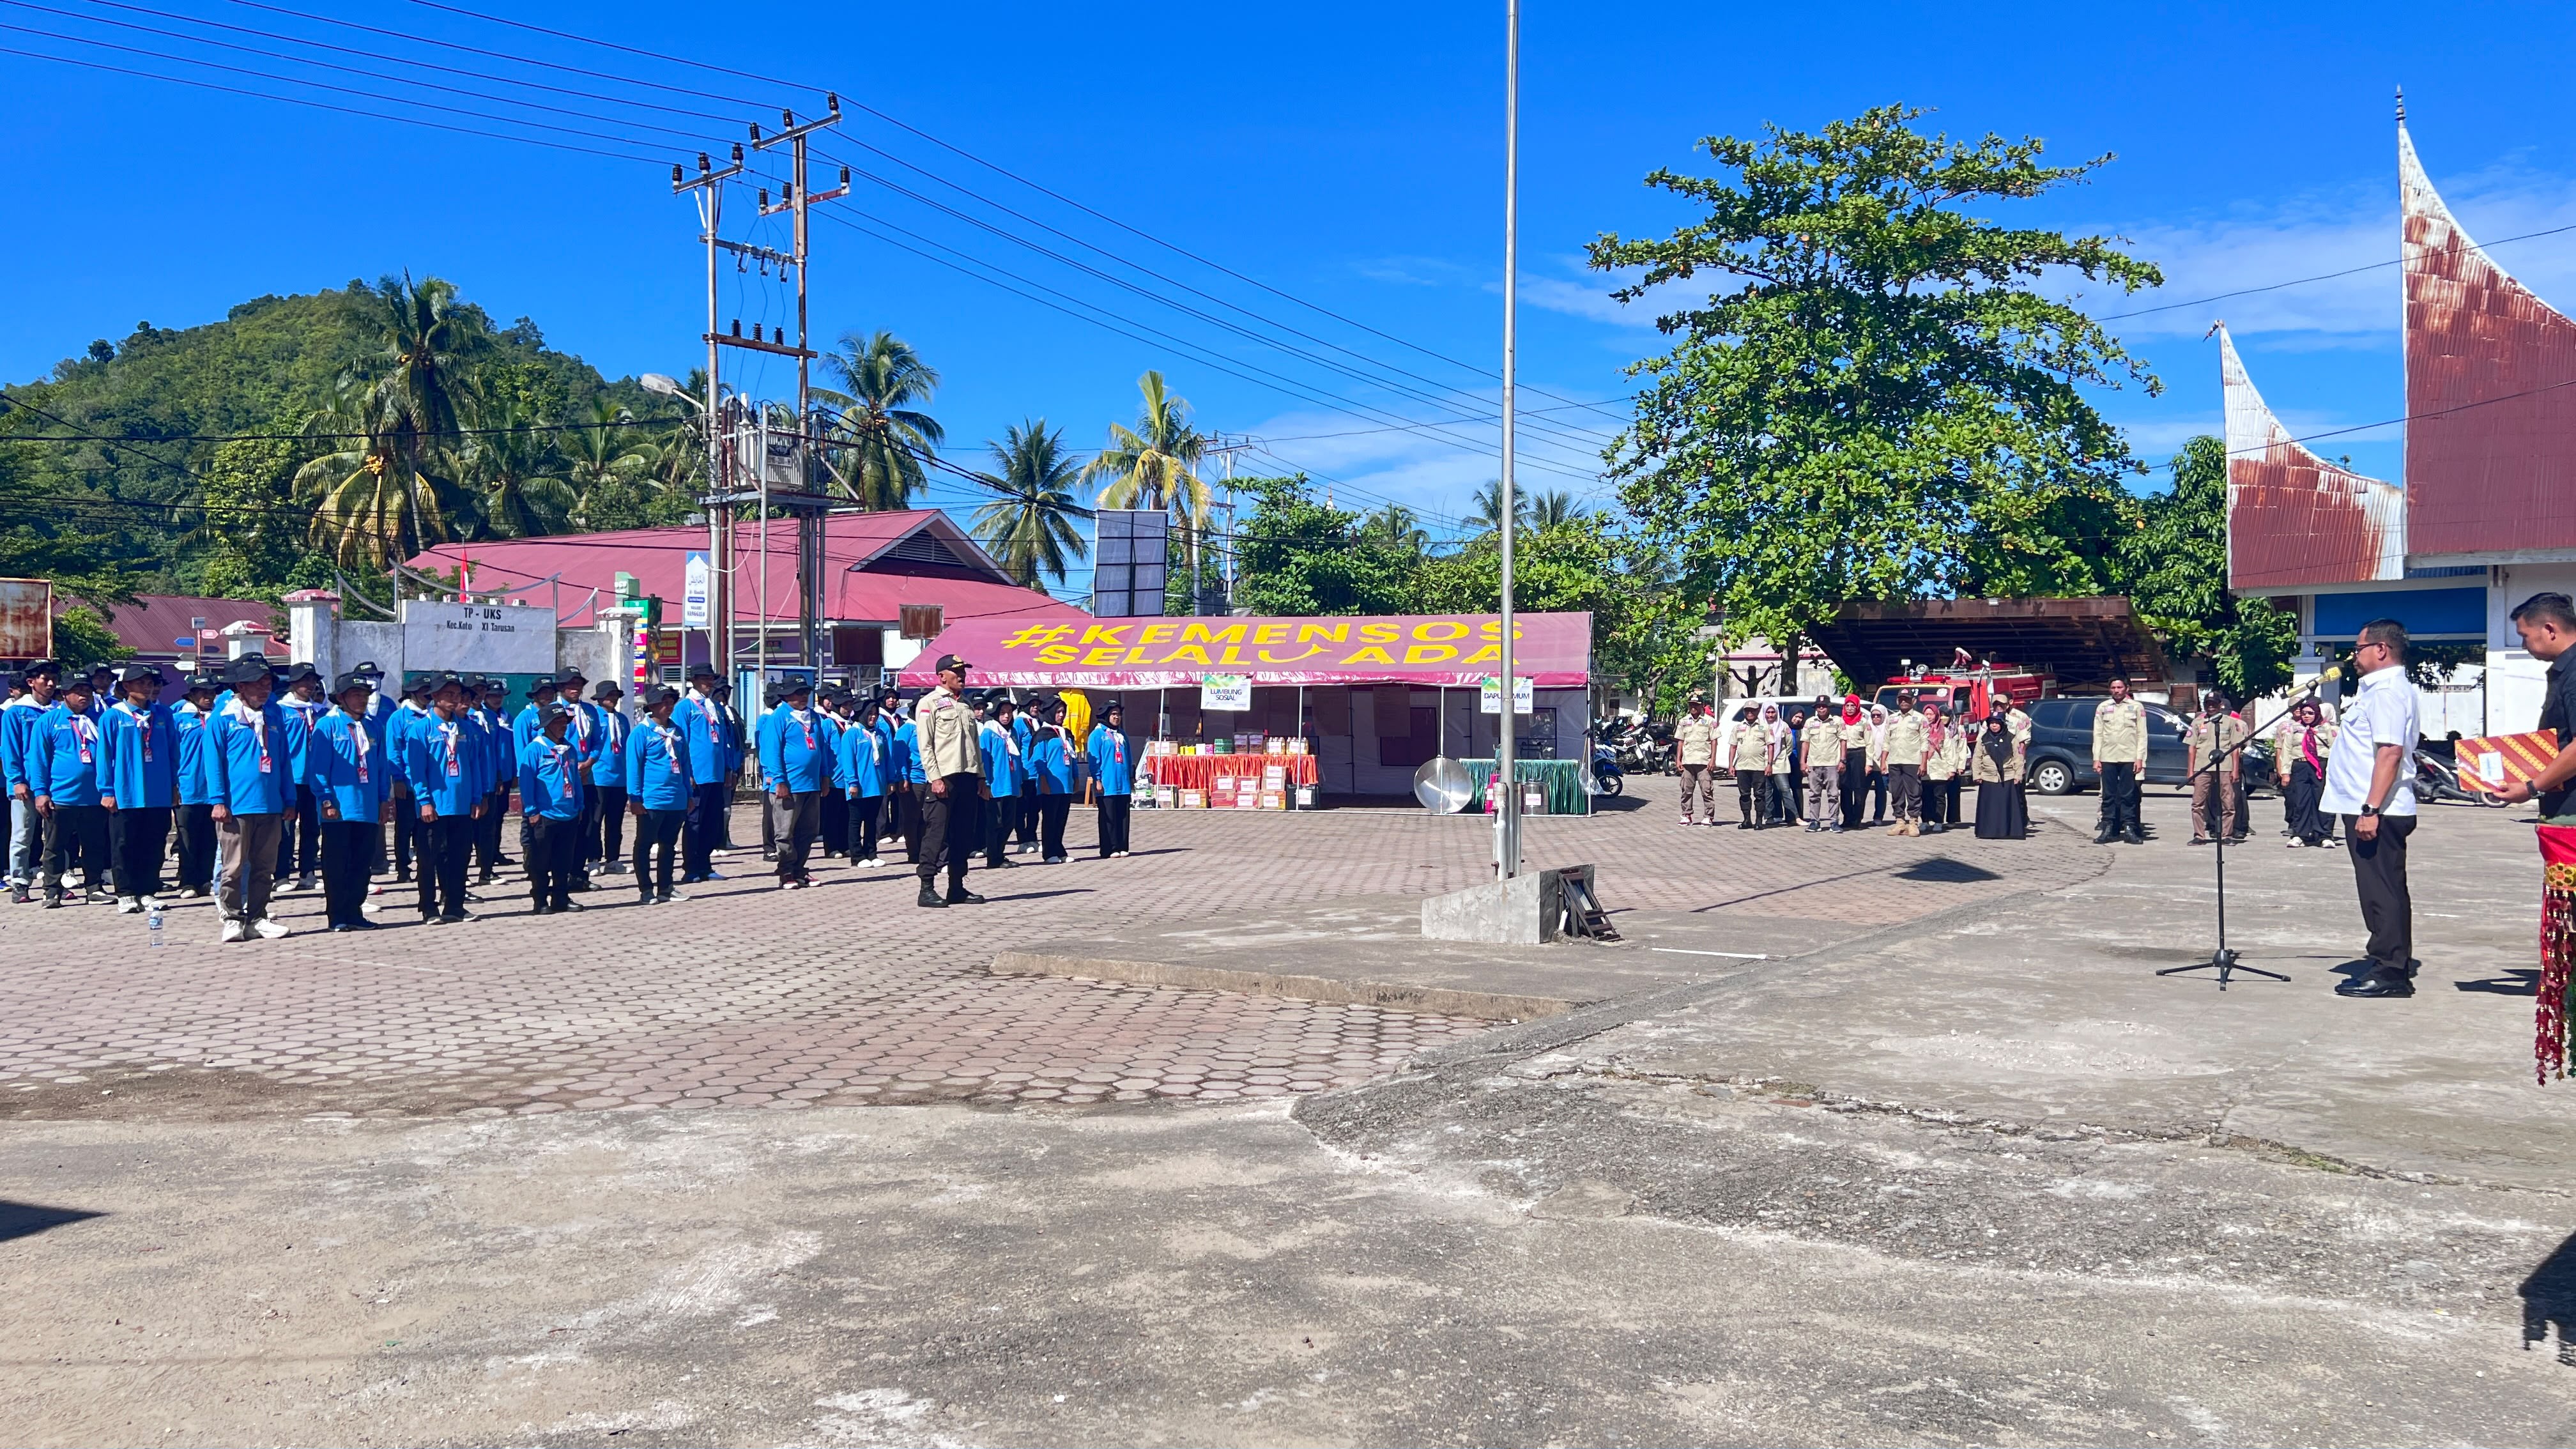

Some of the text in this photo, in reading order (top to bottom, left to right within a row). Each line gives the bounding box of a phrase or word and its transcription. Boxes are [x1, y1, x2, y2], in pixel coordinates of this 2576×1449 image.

[464, 608, 473, 618] TP
[484, 608, 502, 620] UKS
[482, 622, 489, 631] XI
[491, 623, 515, 632] Tarusan
[1000, 620, 1524, 648] #KEMENSOS
[1033, 643, 1521, 665] SELALU ADA
